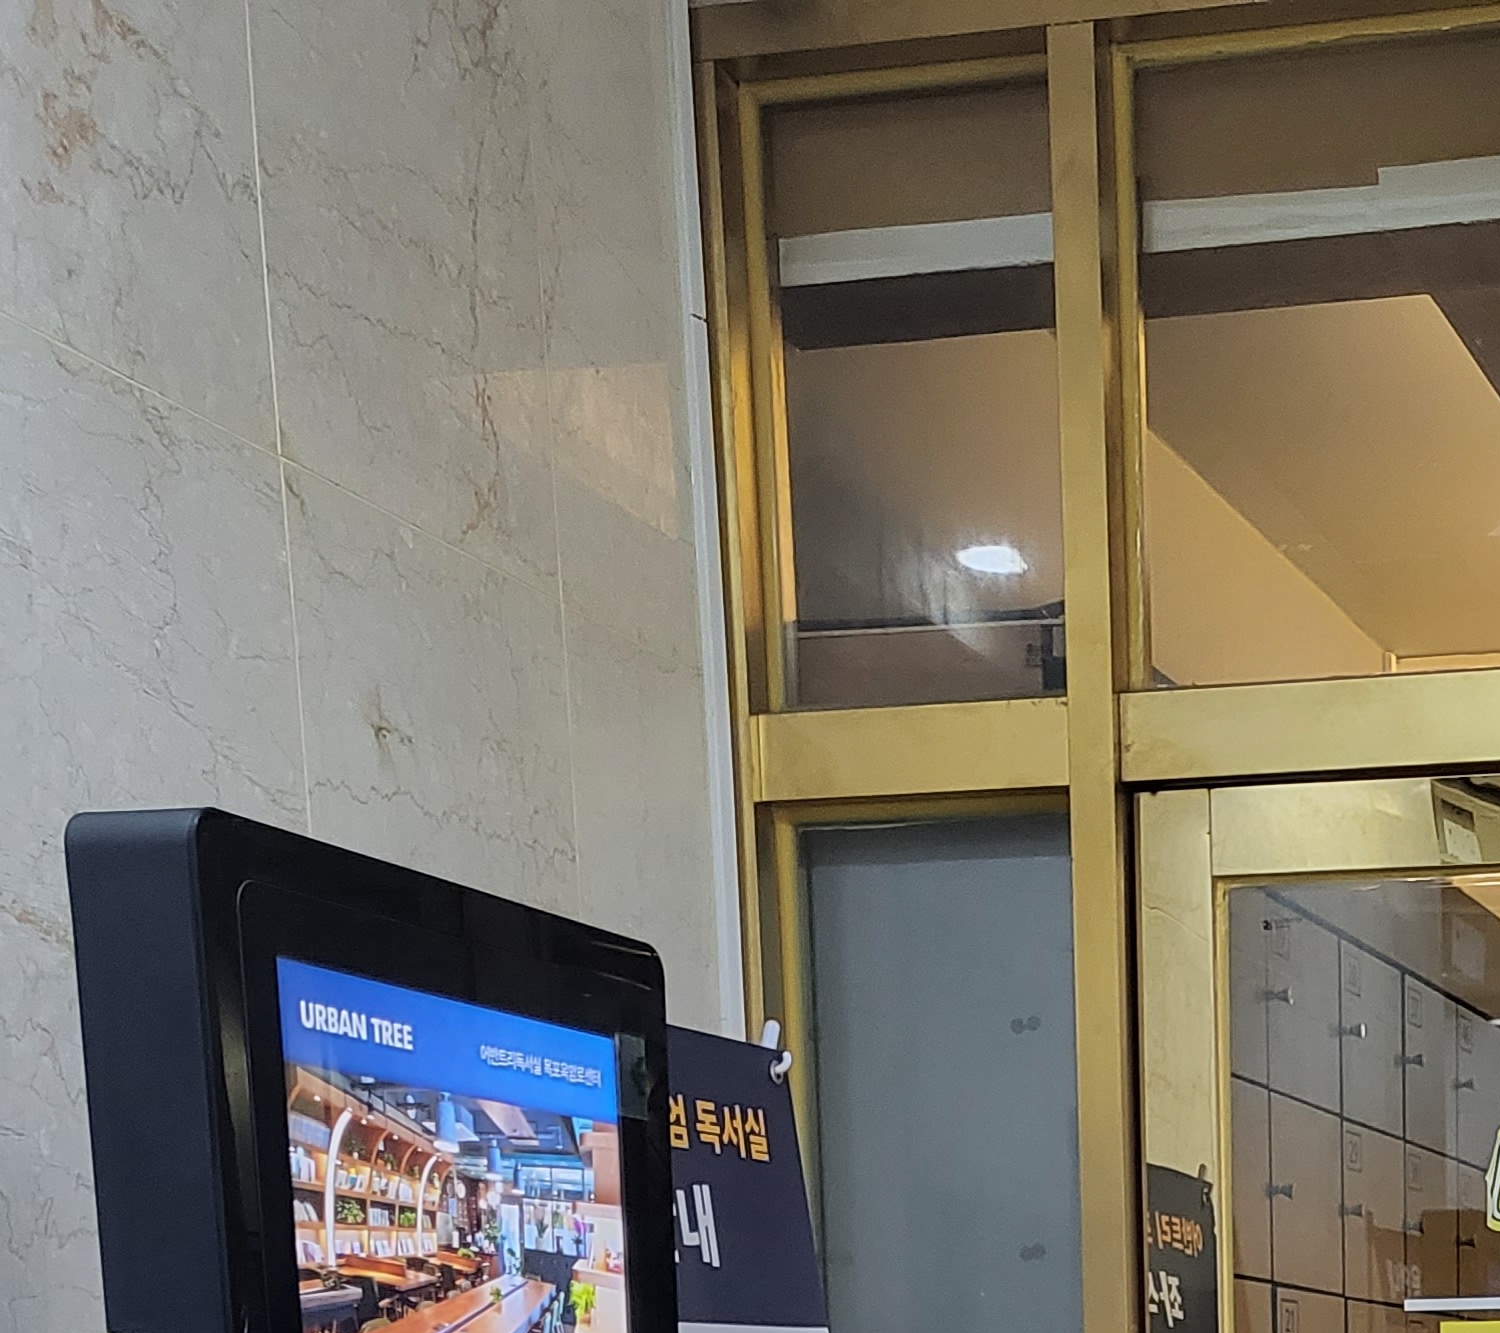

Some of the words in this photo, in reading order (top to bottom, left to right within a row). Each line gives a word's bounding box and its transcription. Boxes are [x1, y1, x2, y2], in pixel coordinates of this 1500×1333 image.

[300, 1000, 367, 1041] URBAN
[371, 1017, 414, 1050] TREE
[695, 1099, 771, 1163] 독서실
